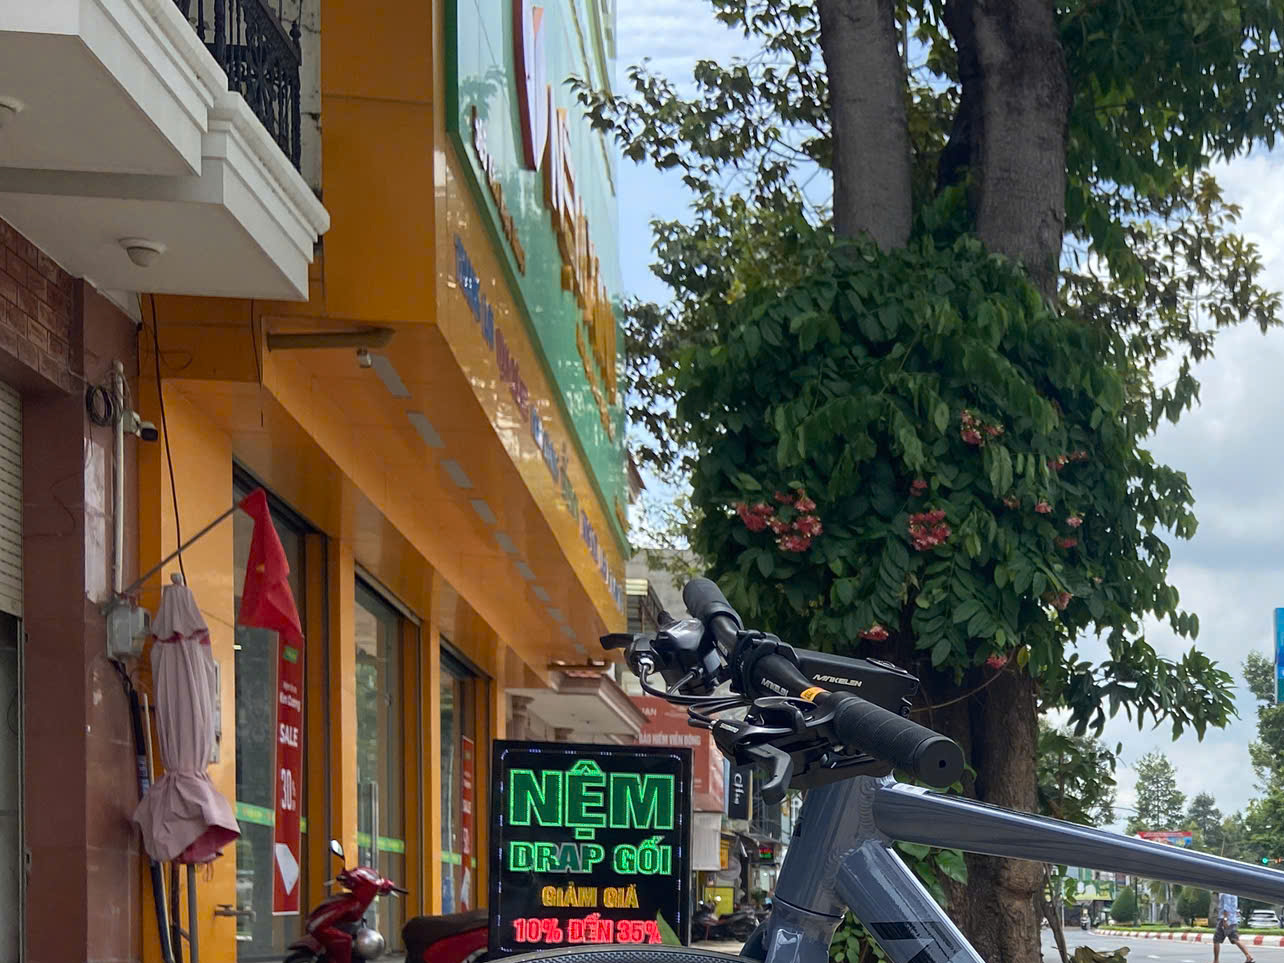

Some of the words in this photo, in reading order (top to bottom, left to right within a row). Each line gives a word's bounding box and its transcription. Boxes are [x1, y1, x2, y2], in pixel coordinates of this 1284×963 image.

[279, 723, 298, 748] SALE
[509, 759, 676, 840] NỆM
[509, 841, 605, 874] DRAP
[613, 835, 673, 875] GỐI
[513, 918, 564, 943] 10%
[616, 919, 663, 944] 35%
